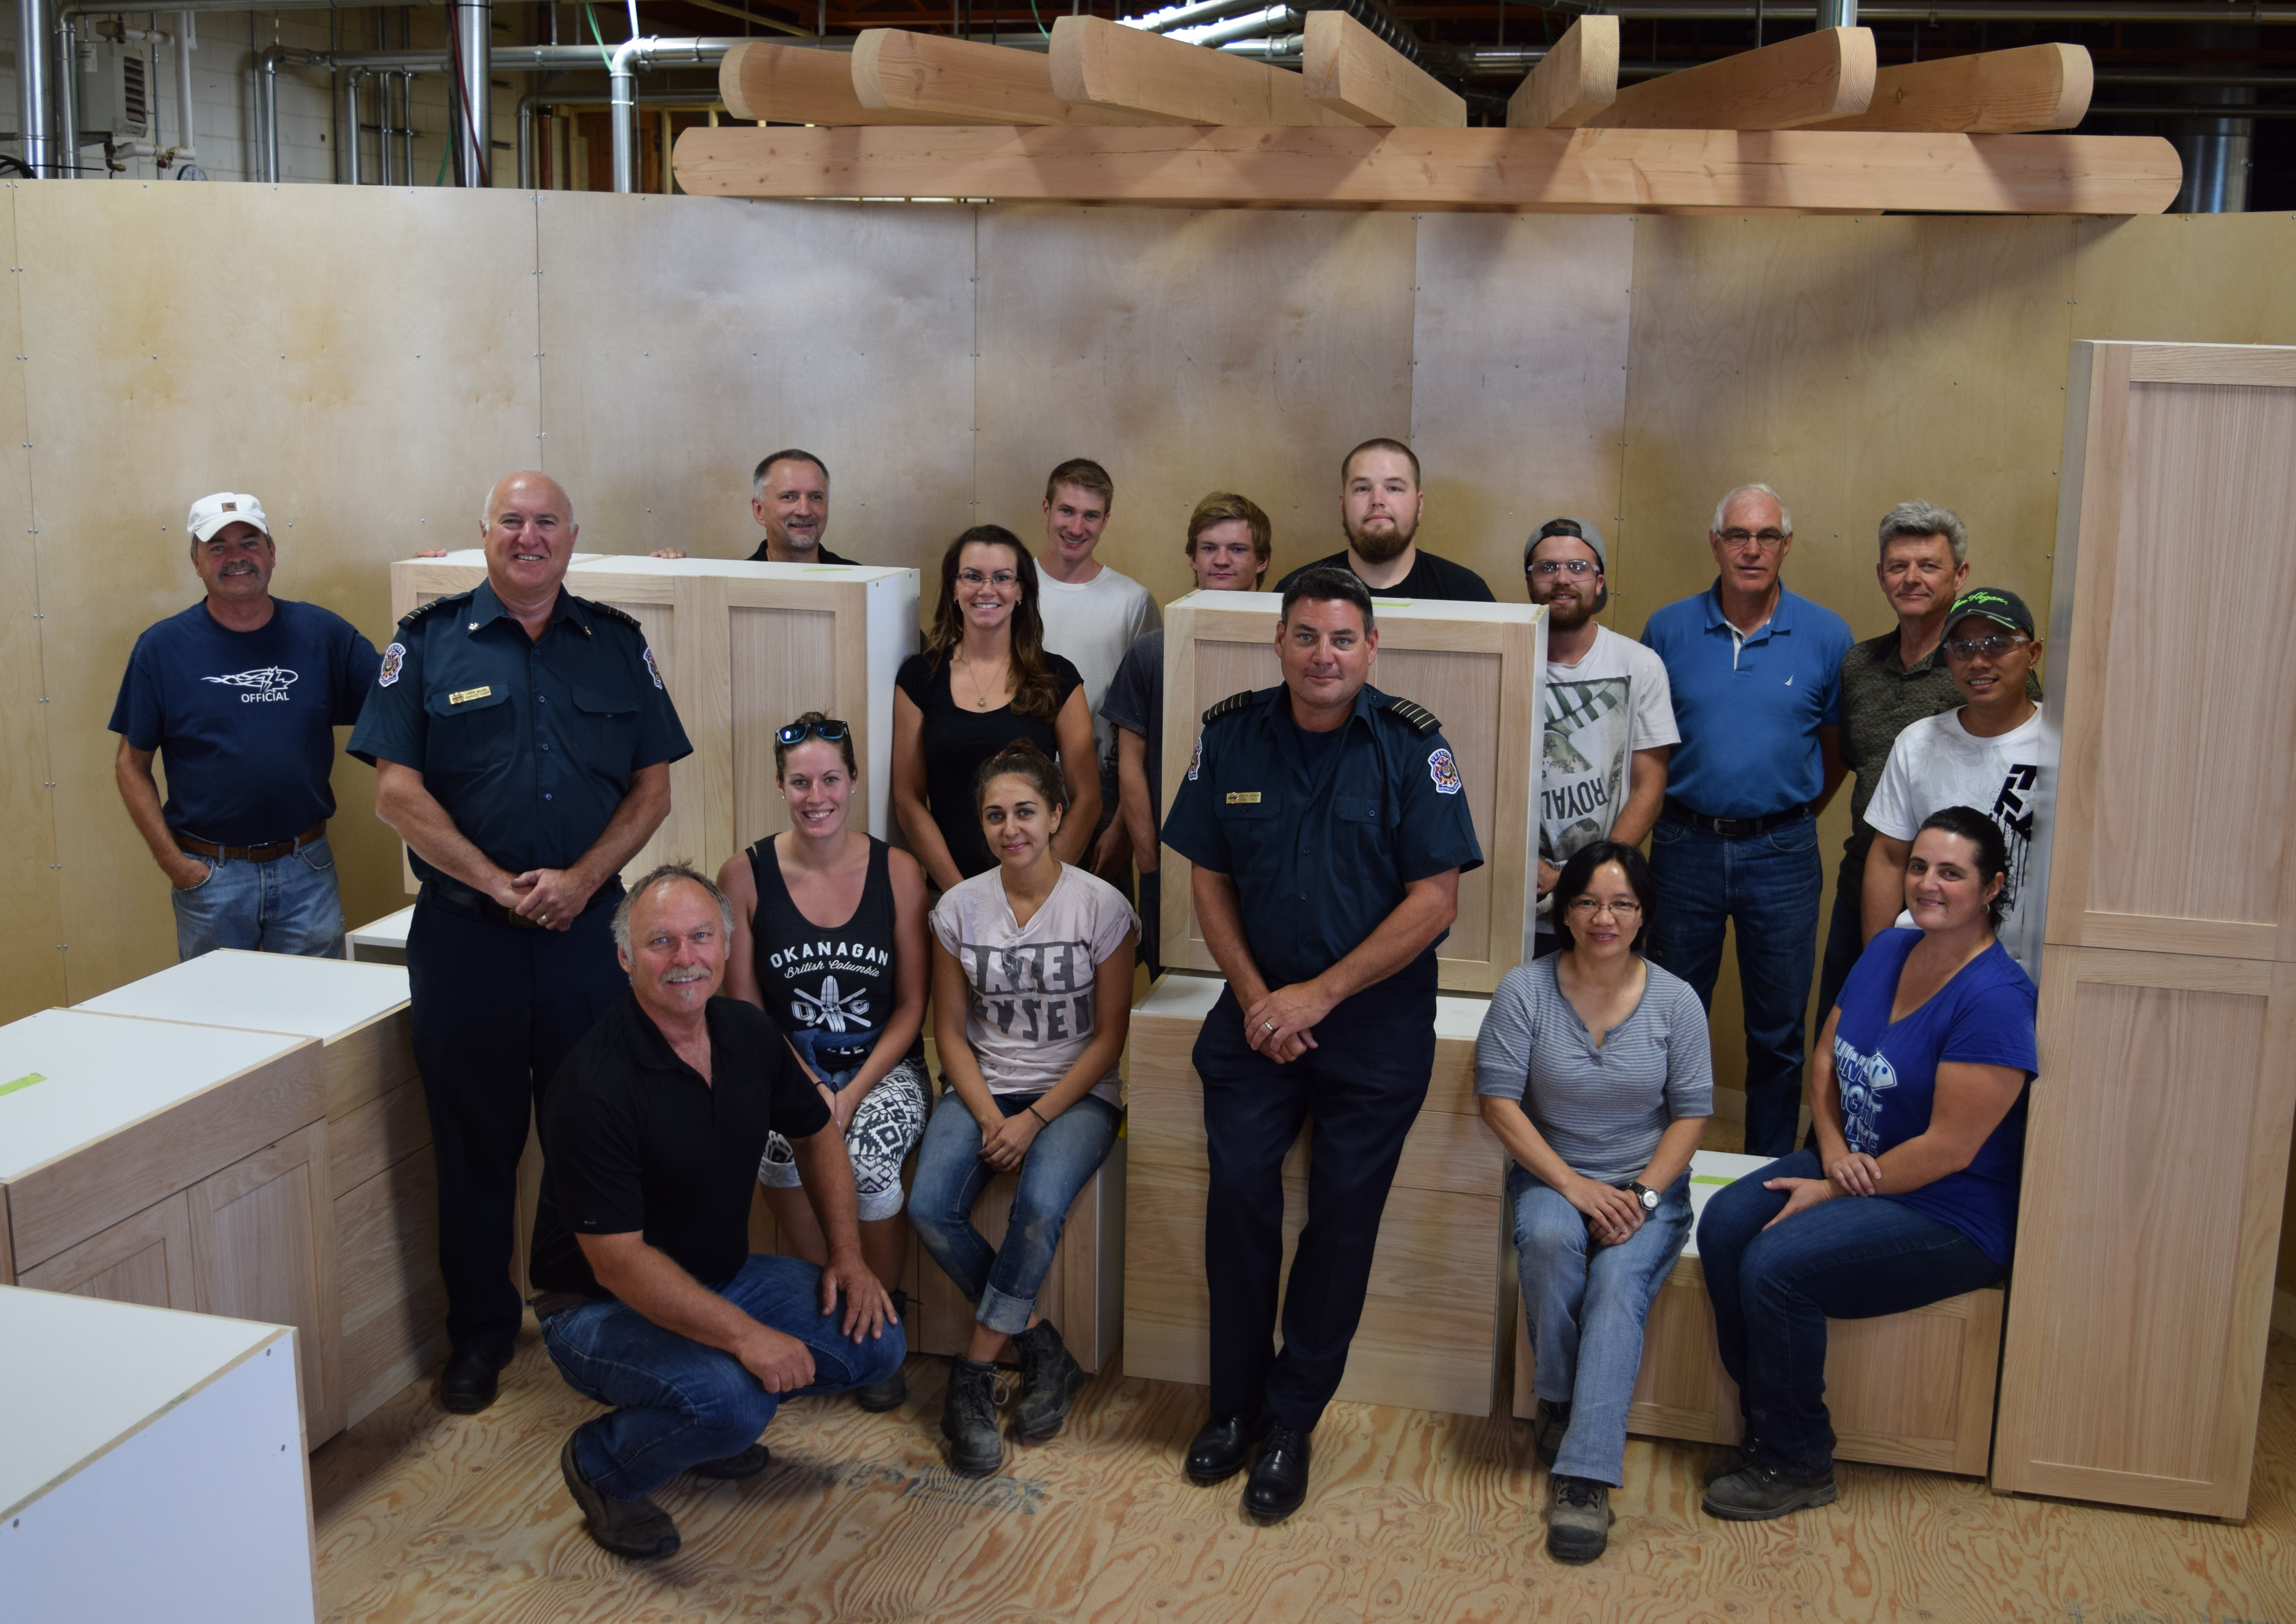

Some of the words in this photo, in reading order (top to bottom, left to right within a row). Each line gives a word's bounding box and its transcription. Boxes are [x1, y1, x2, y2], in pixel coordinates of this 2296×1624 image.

[1968, 592, 2008, 605] Hogan
[241, 692, 290, 702] OFFICIAL
[1430, 751, 1450, 762] VERNON
[1541, 777, 1608, 820] ROYAL
[770, 941, 888, 968] OKANAGAN
[784, 960, 825, 978] British
[829, 960, 880, 977] Columbia
